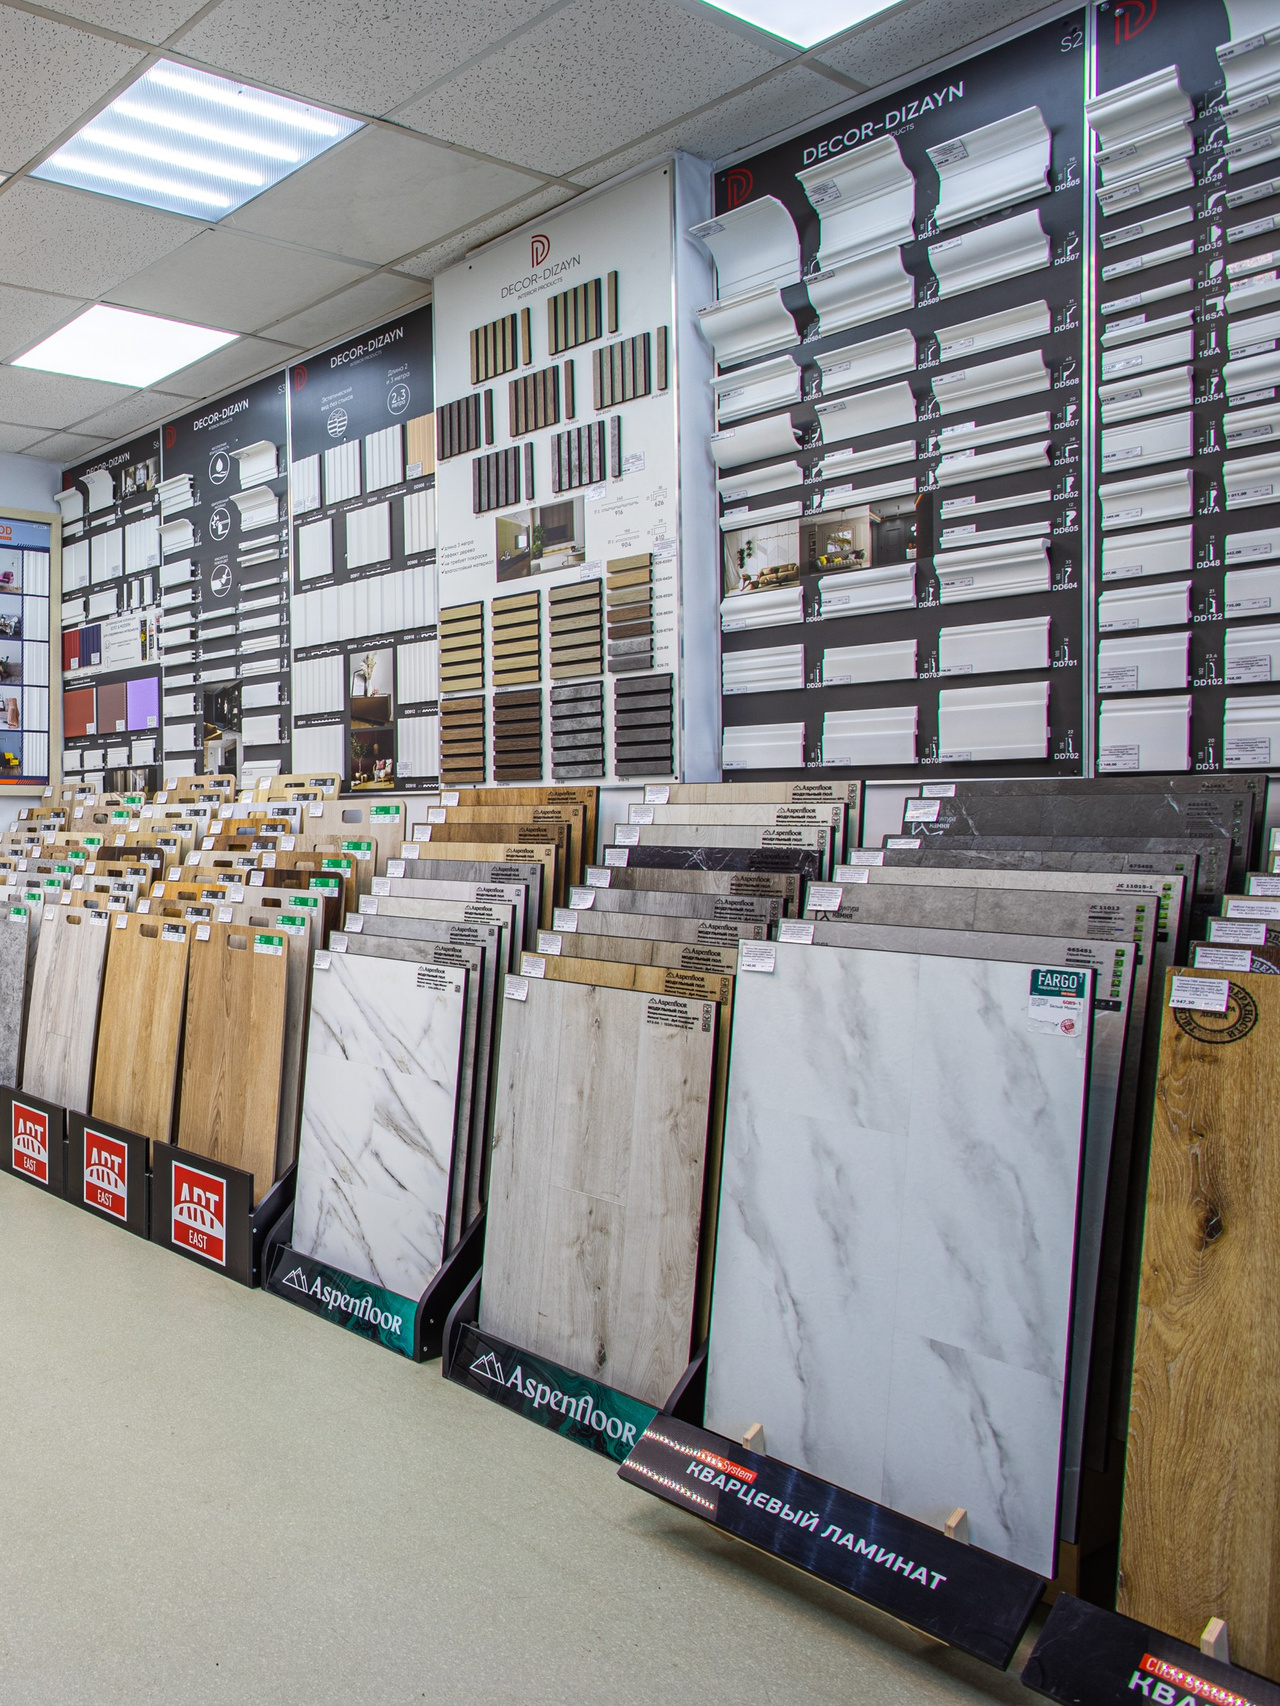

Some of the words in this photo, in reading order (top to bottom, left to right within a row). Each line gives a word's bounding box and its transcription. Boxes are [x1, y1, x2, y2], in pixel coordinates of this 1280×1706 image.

[1060, 31, 1083, 52] S2
[803, 80, 964, 165] DECOR-DIZAYN
[1199, 140, 1223, 155] DD42
[1199, 172, 1223, 186] DD28
[1198, 206, 1223, 219] DD26
[1198, 241, 1223, 253] DD35
[1054, 252, 1080, 266] DD507
[501, 254, 581, 299] DECOR-DIZAYN
[538, 277, 563, 294] PRODUCTS
[1198, 277, 1222, 289] DD02
[1196, 311, 1224, 323] 116SA
[1054, 320, 1079, 333] DD501
[330, 327, 404, 368] DECOR-DIZAYN
[1198, 348, 1221, 358] 156A
[918, 359, 940, 370] DD502
[278, 384, 286, 395] S3
[1054, 377, 1079, 390] DD508
[1195, 391, 1224, 405] DD354
[193, 399, 249, 431] DECOR-DIZAYN
[918, 411, 940, 422] DD512
[1054, 418, 1079, 430] DD607
[1198, 445, 1220, 455] 150A
[1054, 455, 1079, 466] DD801
[1053, 490, 1079, 501] DD602
[1198, 506, 1220, 515] 147A
[1053, 525, 1079, 535] DD605
[1196, 559, 1220, 569] DD48
[1052, 581, 1078, 591] DD604
[918, 600, 940, 608] DD601
[1194, 613, 1223, 622] DD122
[1052, 659, 1078, 668] DD701
[1194, 678, 1223, 686] DD102
[1054, 752, 1079, 760] DD702
[832, 911, 853, 920] камня
[1038, 972, 1077, 989] FARGO
[23, 1156, 37, 1172] EAST
[97, 1189, 113, 1207] EAST
[188, 1229, 208, 1250] EAST
[722, 1459, 754, 1482] System
[685, 1460, 820, 1532] КВАРЦЕВЫЙ
[821, 1523, 947, 1590] ЛАМИНАТ
